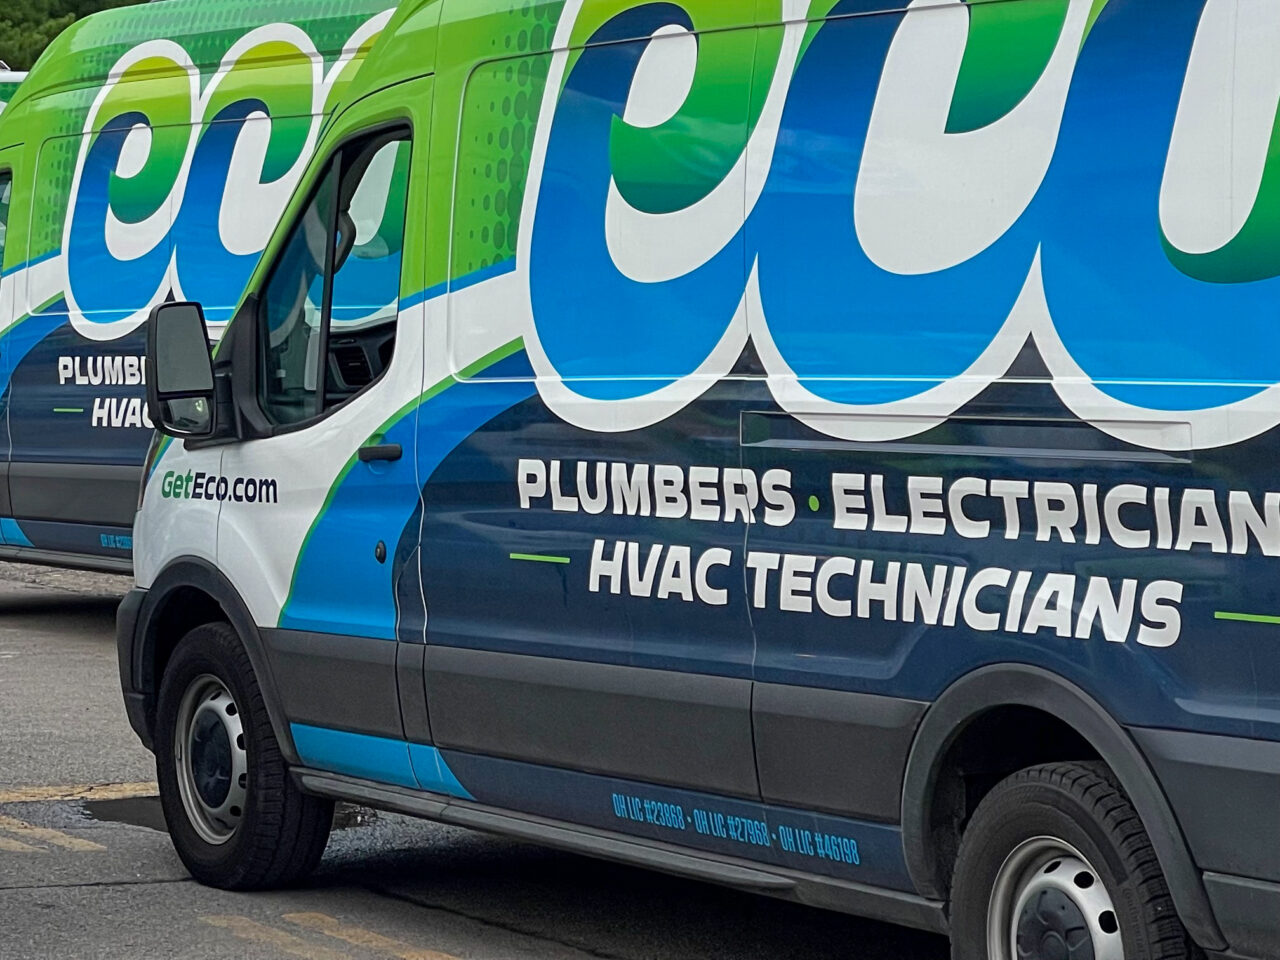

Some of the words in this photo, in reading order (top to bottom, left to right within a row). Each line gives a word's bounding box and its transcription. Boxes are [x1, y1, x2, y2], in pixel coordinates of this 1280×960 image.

[58, 356, 146, 385] PLUMB
[161, 469, 278, 503] GetEco.com
[518, 459, 794, 527] PLUMBERS
[831, 472, 1280, 556] ELECTRICIAN
[588, 539, 731, 606] HVAC
[746, 553, 1184, 647] TECHNICIANS
[612, 793, 628, 818] OH
[627, 796, 644, 822] LIC
[693, 810, 710, 834] OH
[711, 814, 727, 839] LIC
[727, 817, 771, 848] #27968
[778, 825, 796, 852] OH
[795, 830, 815, 856] LIC
[815, 833, 860, 865] #46198
